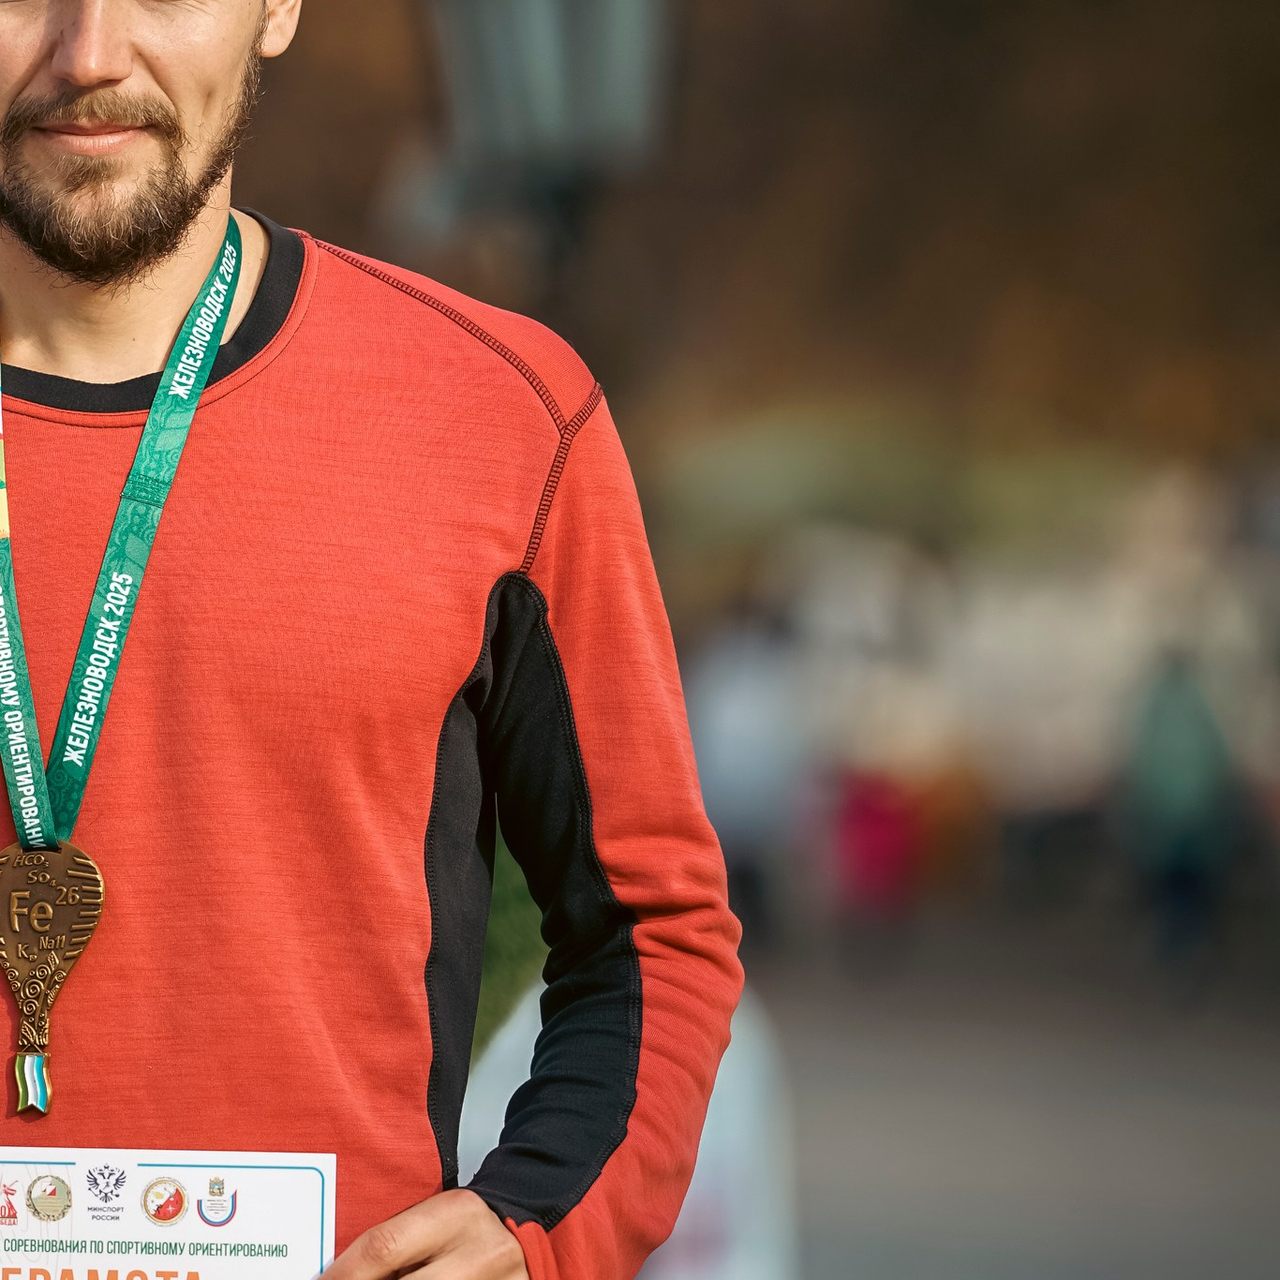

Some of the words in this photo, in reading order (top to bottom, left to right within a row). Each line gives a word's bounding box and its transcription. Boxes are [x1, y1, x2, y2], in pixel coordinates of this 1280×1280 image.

[168, 275, 229, 400] ЖЕЛЕЗНОВОДСК
[219, 240, 237, 283] 2025
[63, 616, 122, 767] ЖЕЛЕЗНОВОДСК
[103, 572, 133, 617] 2025
[10, 890, 53, 932] Fe
[4, 1239, 87, 1254] СОРЕВНОВАНИЯ
[90, 1241, 104, 1254] ПО
[107, 1241, 186, 1256] СПОРТИВНОМУ
[188, 1243, 288, 1258] ОРИЕНТИРОВАНИЮ
